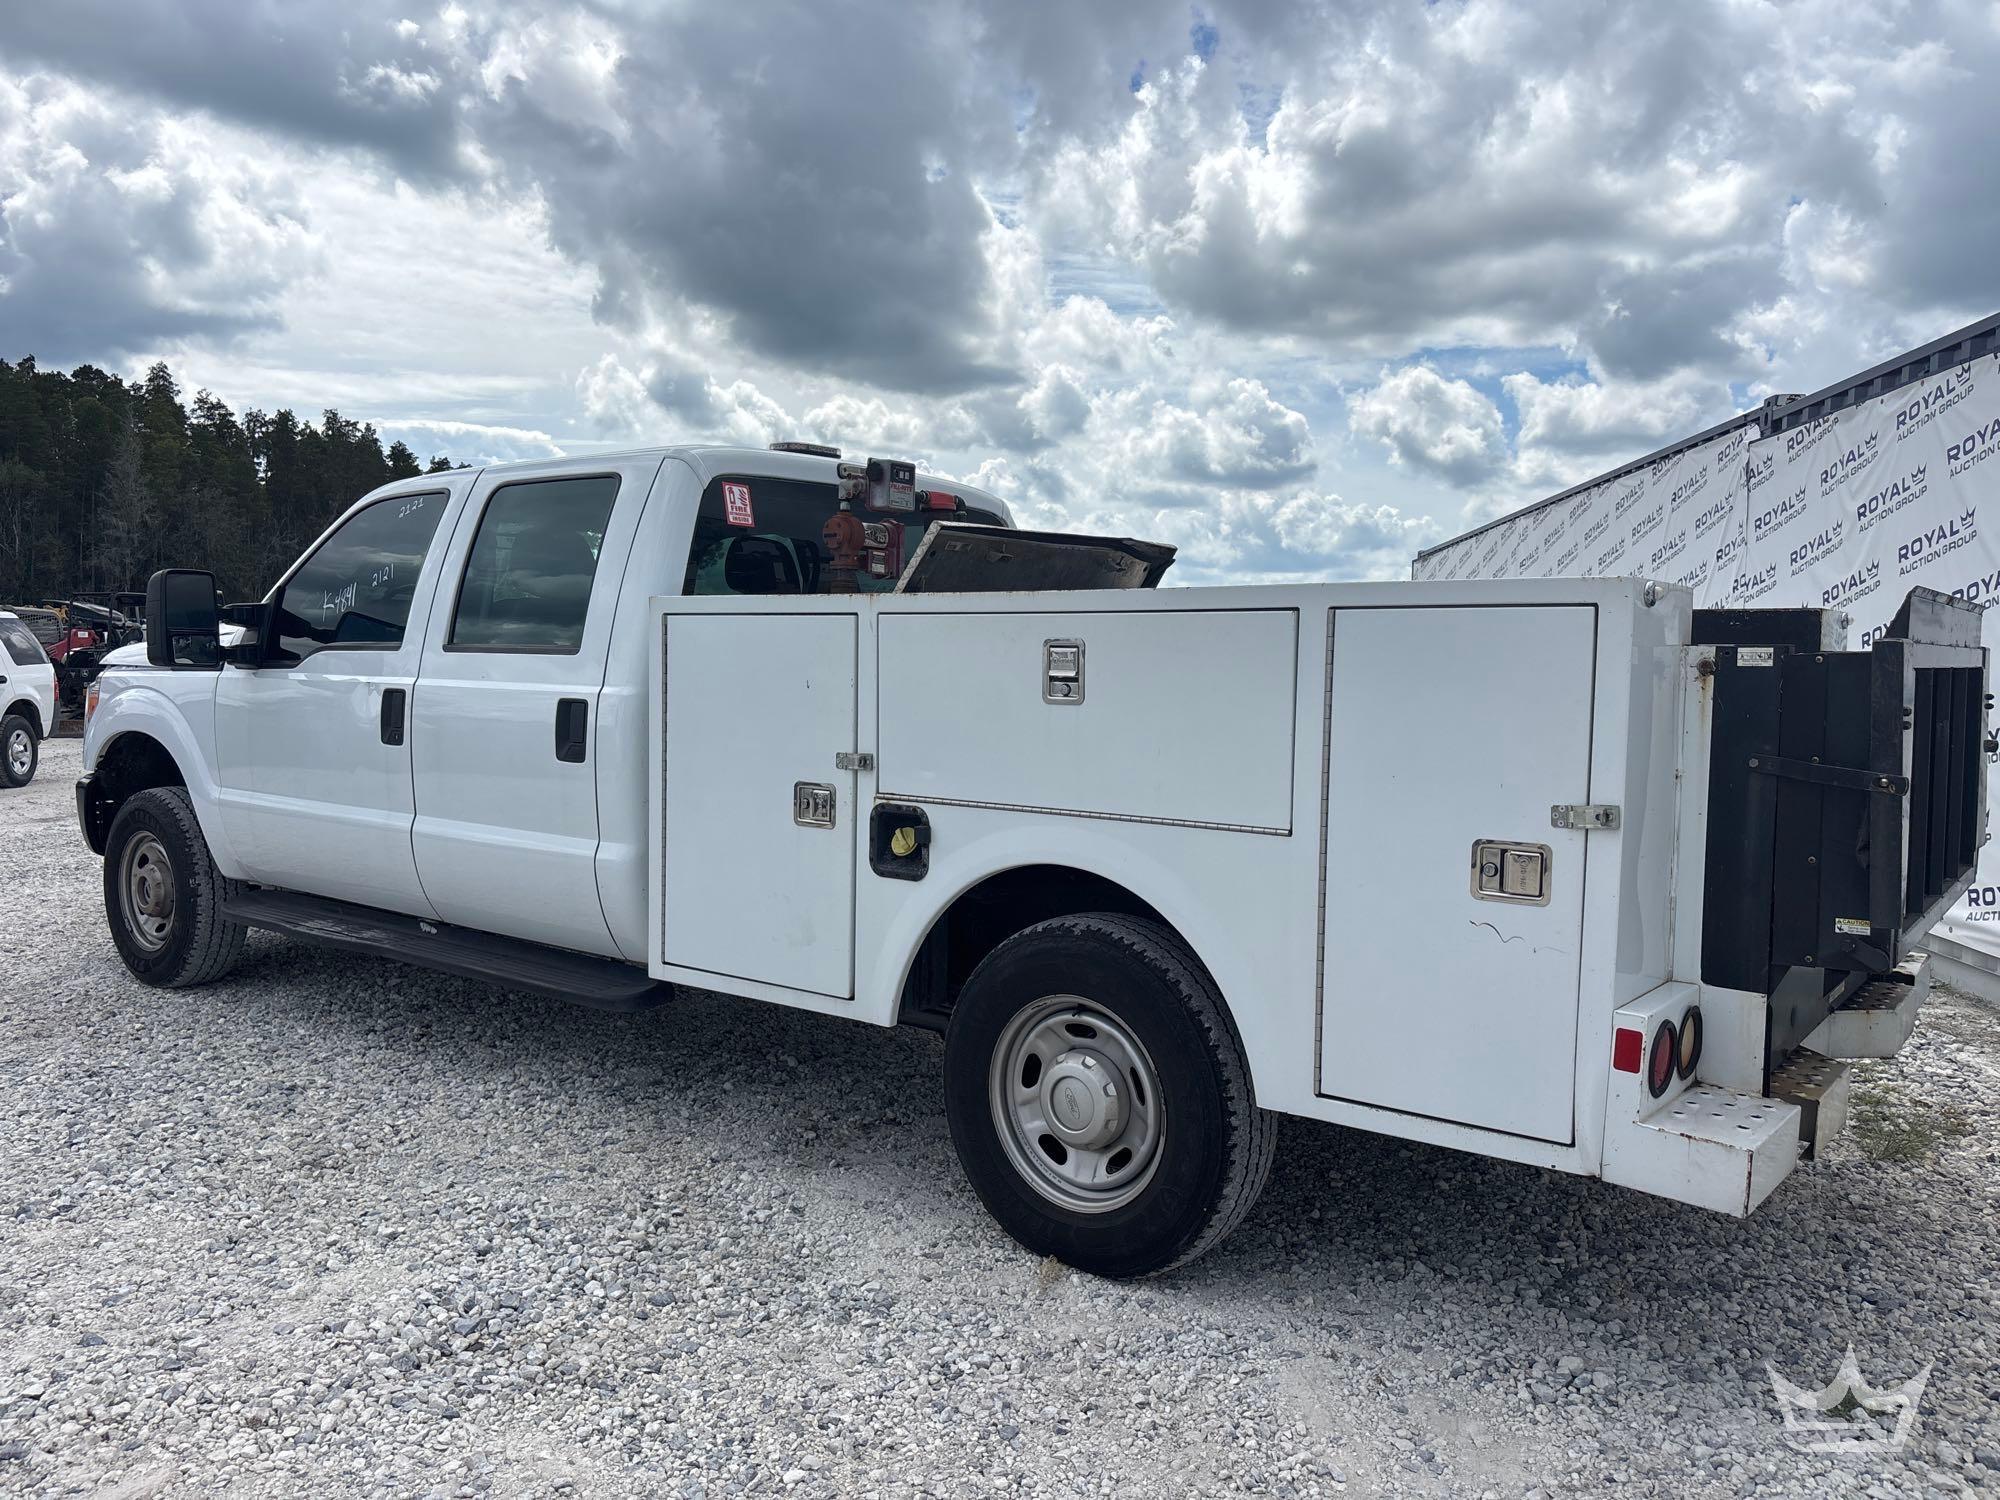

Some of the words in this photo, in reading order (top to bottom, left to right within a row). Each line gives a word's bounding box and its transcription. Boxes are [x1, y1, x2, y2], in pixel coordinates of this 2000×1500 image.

[1896, 379, 1956, 431] ROYAL
[1897, 408, 1937, 443] AUCTION
[1938, 384, 1974, 415] GROUP
[1788, 437, 1817, 464] AUCTION
[1947, 418, 2000, 465] ROYA
[1820, 444, 1865, 488] ROYAL
[1821, 471, 1849, 498] AUCTION
[1850, 450, 1879, 477] GROUP
[1949, 444, 1995, 479] AUCTION
[1615, 485, 1639, 514] ROYAL
[1671, 473, 1699, 506] ROYAL
[1857, 477, 1911, 521] ROYAL
[398, 497, 424, 518] 2121
[730, 505, 748, 513] FIRE
[1695, 500, 1725, 532] ROYAL
[1755, 496, 1796, 533] ROYAL
[1756, 520, 1784, 543] AUCTION
[1784, 503, 1807, 525] GROUP
[1859, 505, 1894, 534] AUCTION
[1895, 485, 1928, 511] GROUP
[1632, 512, 1657, 539] ROYAL
[1898, 520, 1960, 564] ROYAL
[1651, 536, 1679, 565] ROYAL
[1716, 537, 1738, 563] ROY
[1790, 530, 1833, 566] ROYAL
[1899, 548, 1941, 577] AUCTION
[1942, 529, 1978, 555] GROUP
[372, 563, 394, 587] 2121
[1791, 554, 1820, 578] AUCTION
[1756, 580, 1777, 598] GROUP
[1822, 570, 1867, 606] ROYAL
[1831, 595, 1853, 611] CTION
[1853, 579, 1881, 602] GROUP
